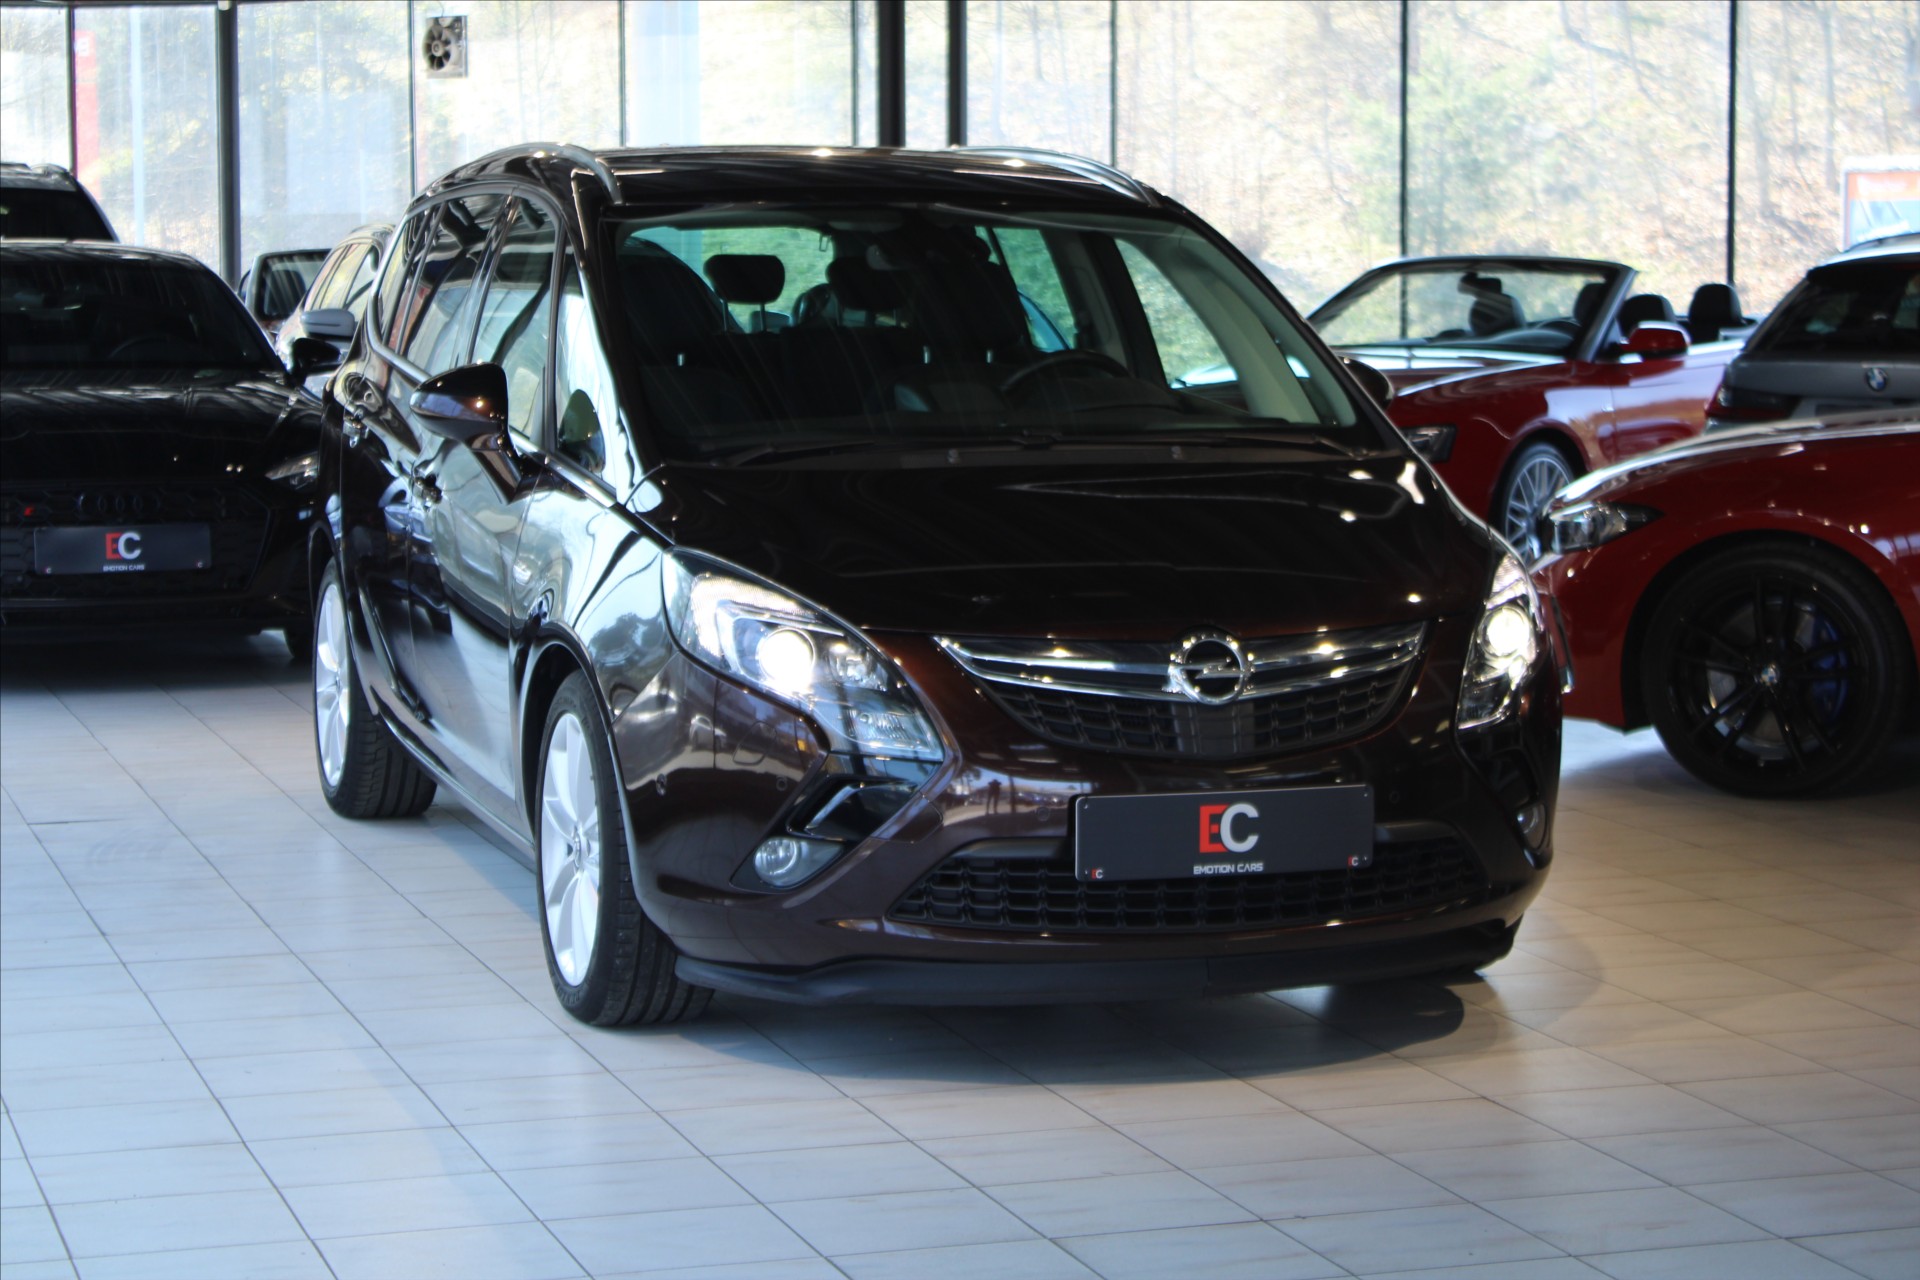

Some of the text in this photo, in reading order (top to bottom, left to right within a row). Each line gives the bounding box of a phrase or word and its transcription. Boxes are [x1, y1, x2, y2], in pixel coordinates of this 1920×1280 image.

[105, 532, 141, 560] EC
[1199, 803, 1259, 853] EC
[1193, 862, 1264, 875] EMOTION CARS
